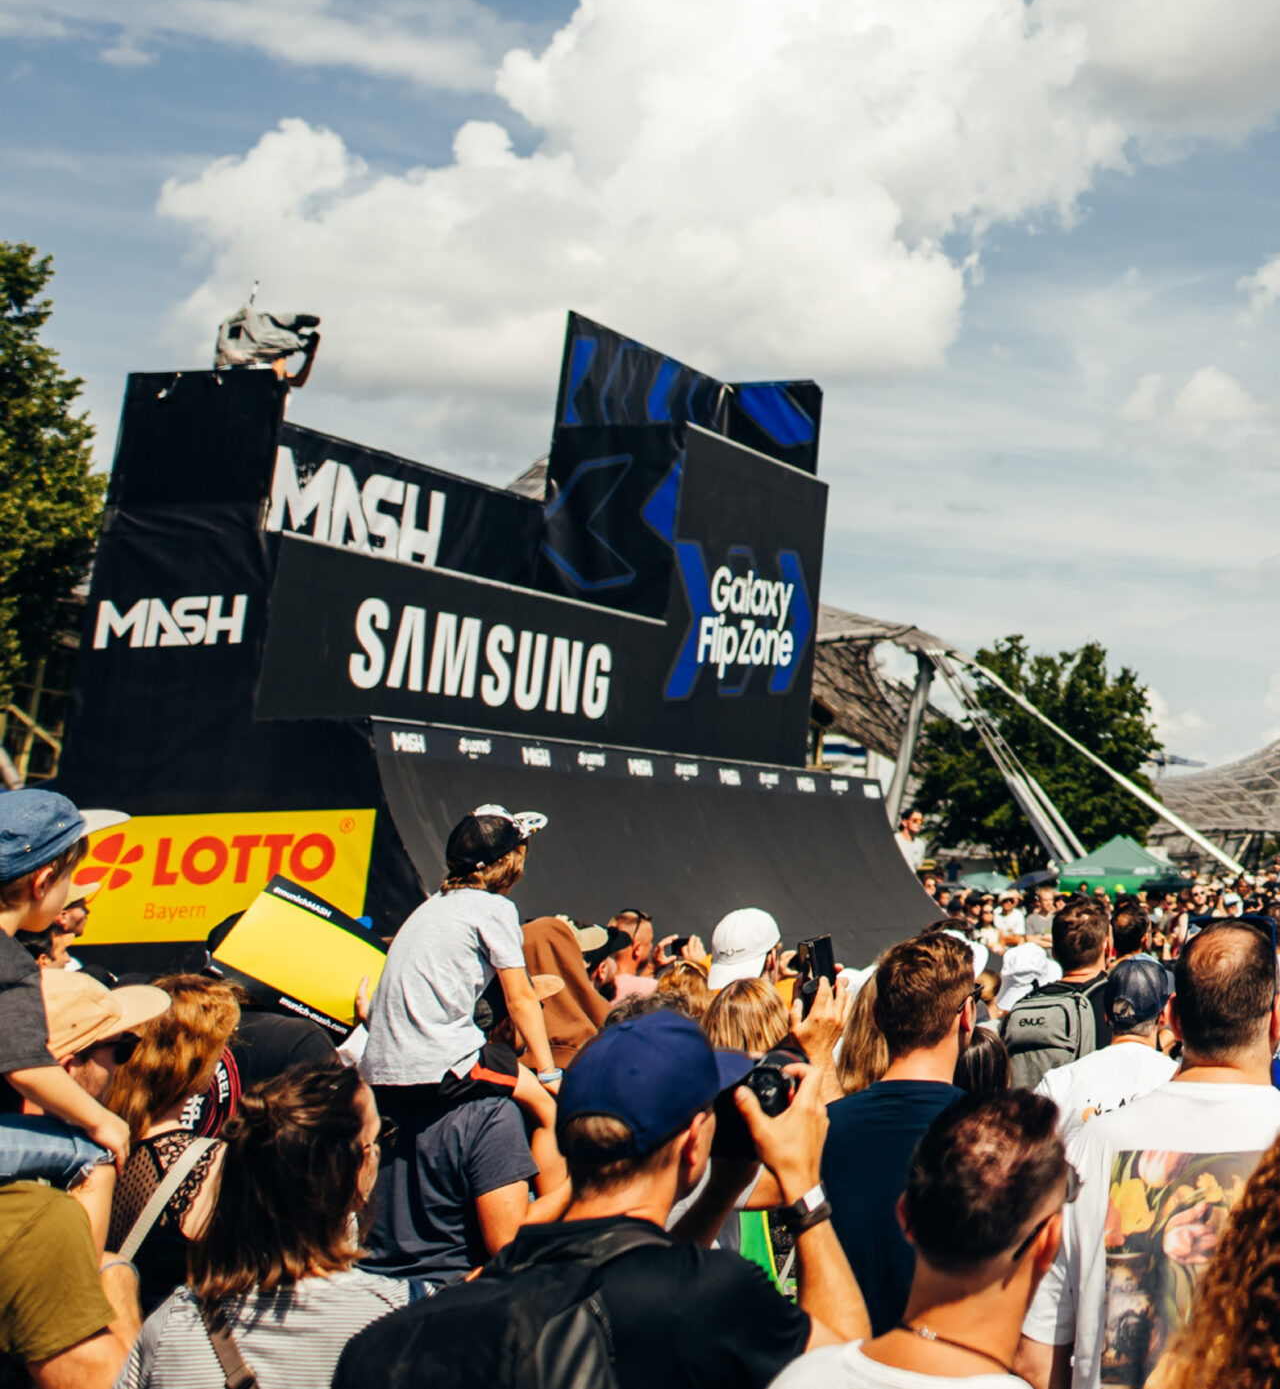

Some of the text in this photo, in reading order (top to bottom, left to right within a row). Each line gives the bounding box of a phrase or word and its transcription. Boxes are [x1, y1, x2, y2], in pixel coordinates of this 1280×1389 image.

[267, 445, 446, 567] MASH
[94, 594, 248, 649] MASH
[711, 566, 794, 632] Galaxy
[348, 597, 612, 720] SAMSUNG
[152, 832, 336, 887] LOTTO
[143, 901, 207, 924] Bayern
